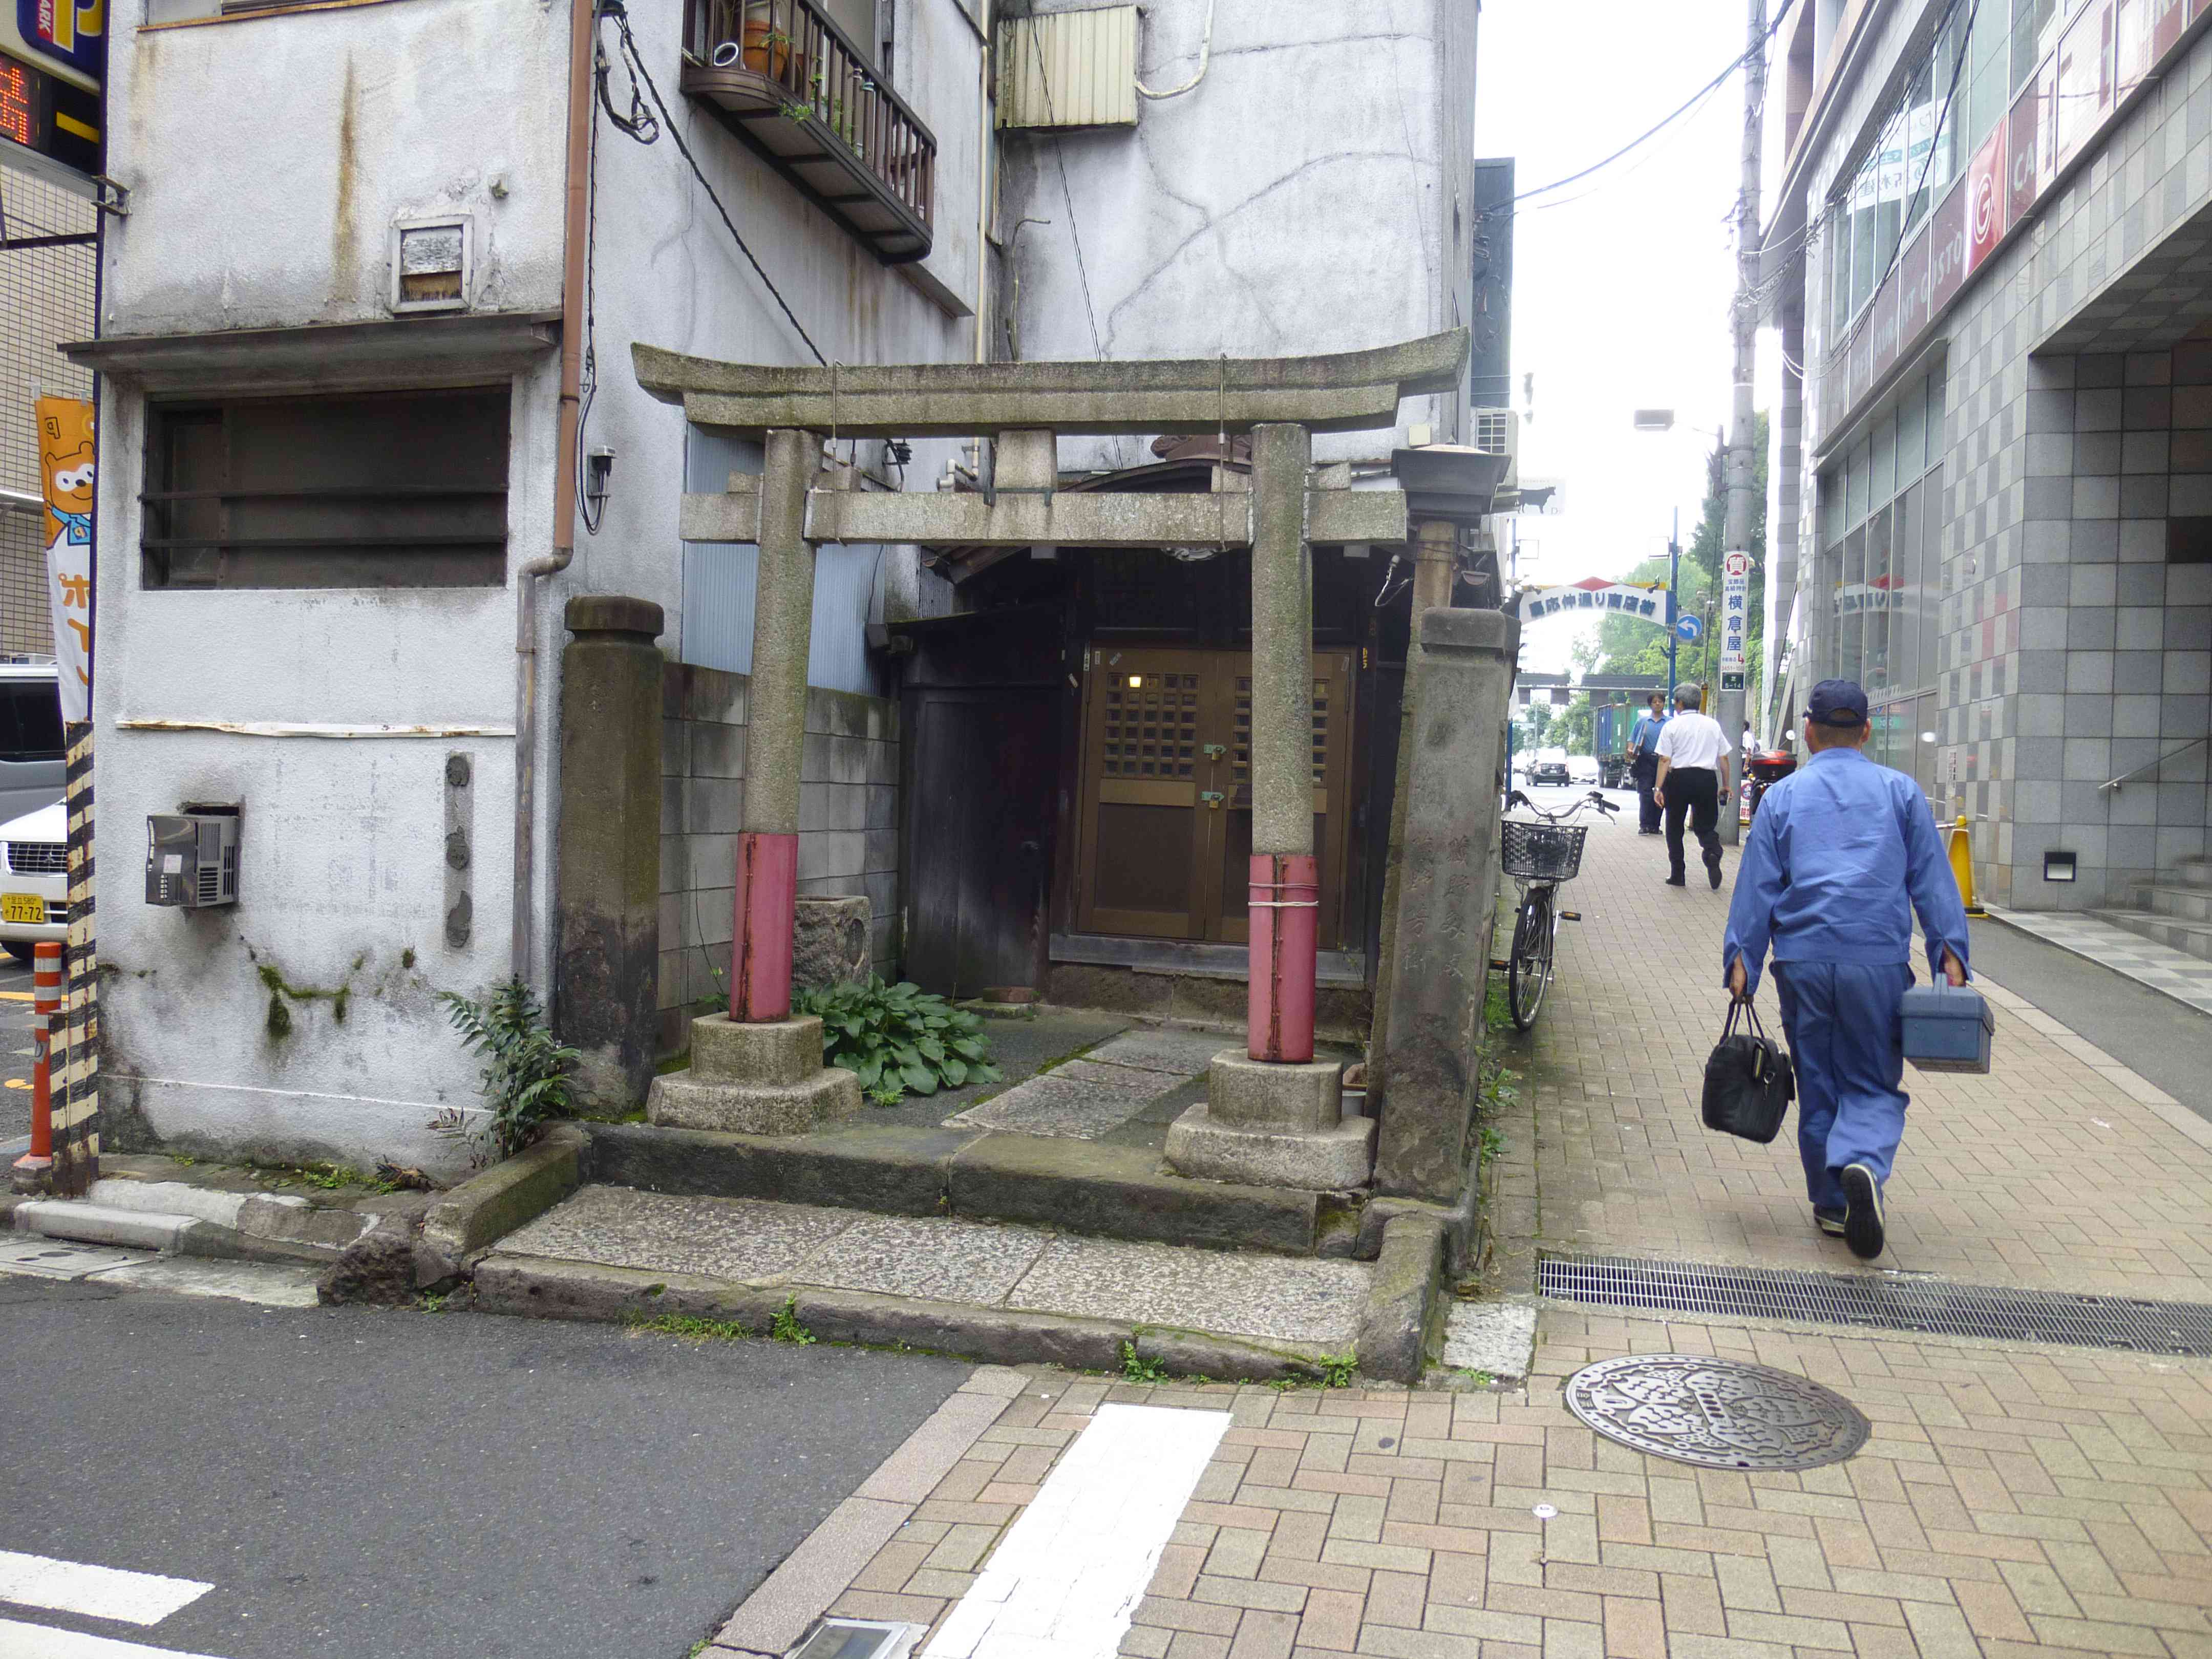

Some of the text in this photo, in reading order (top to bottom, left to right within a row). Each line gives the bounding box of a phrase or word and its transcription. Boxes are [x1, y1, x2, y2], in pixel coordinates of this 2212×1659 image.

[1921, 231, 1963, 304] GUSTO
[1728, 555, 1746, 574] 質
[1727, 594, 1743, 651] 横倉屋
[11, 906, 41, 921] 77-72
